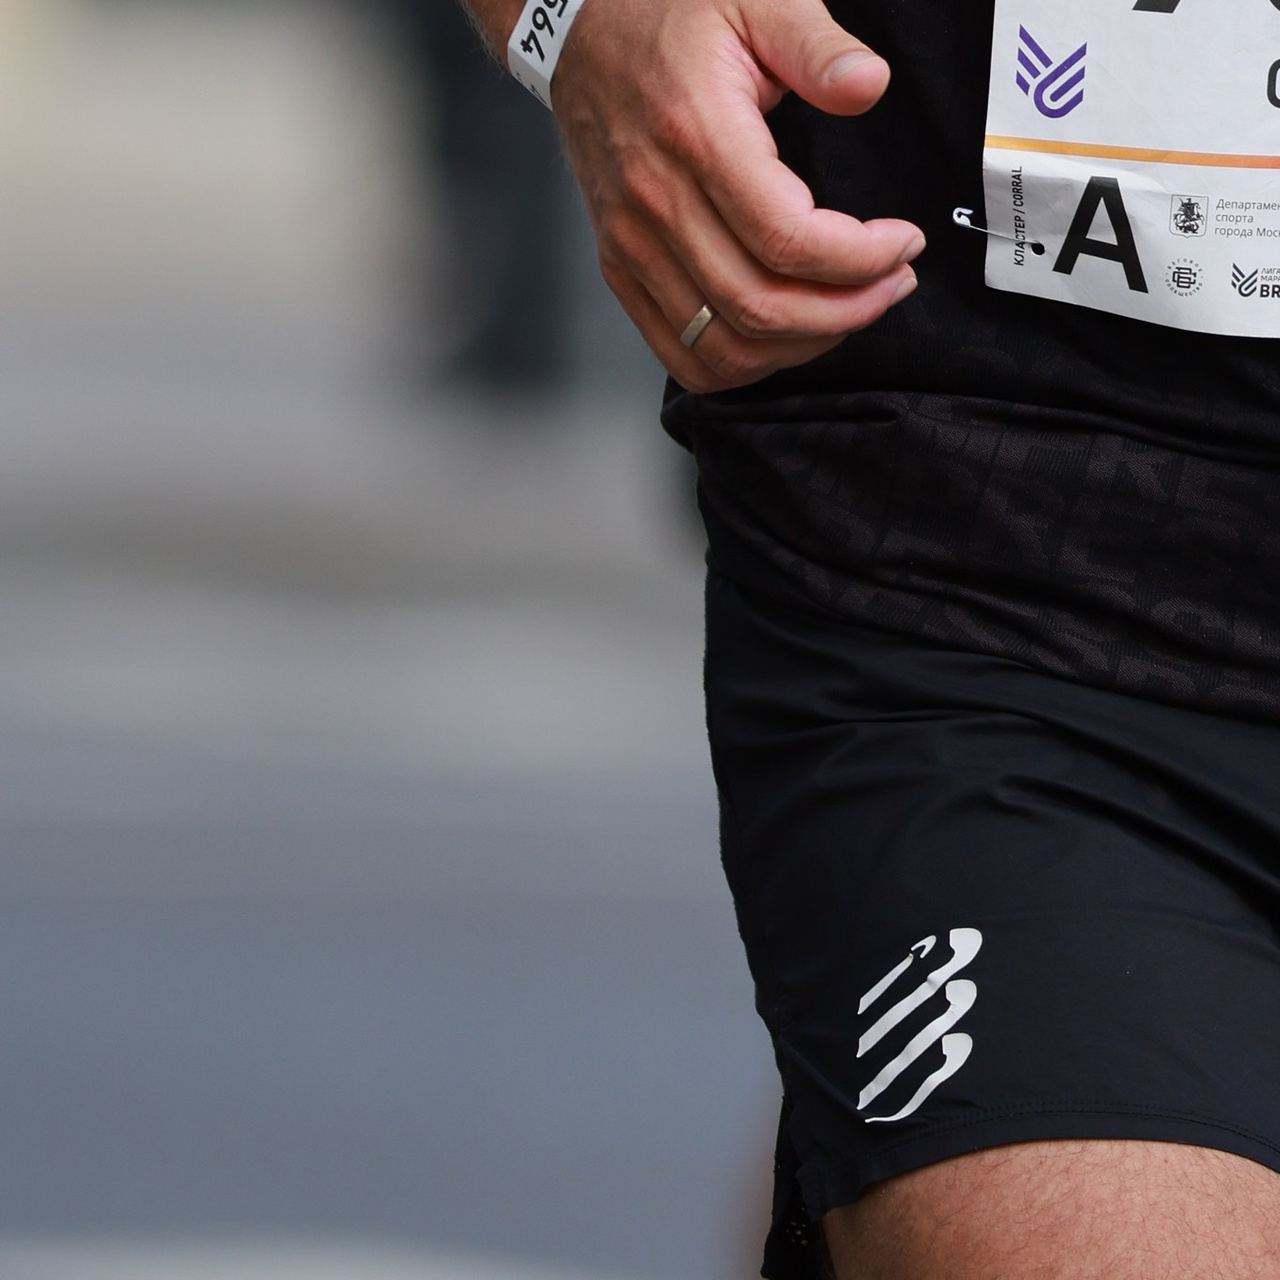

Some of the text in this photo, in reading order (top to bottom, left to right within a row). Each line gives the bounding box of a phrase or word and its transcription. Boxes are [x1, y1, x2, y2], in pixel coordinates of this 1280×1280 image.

[1011, 166, 1024, 207] CORRAL
[1215, 213, 1254, 224] спорта
[1214, 227, 1253, 239] города
